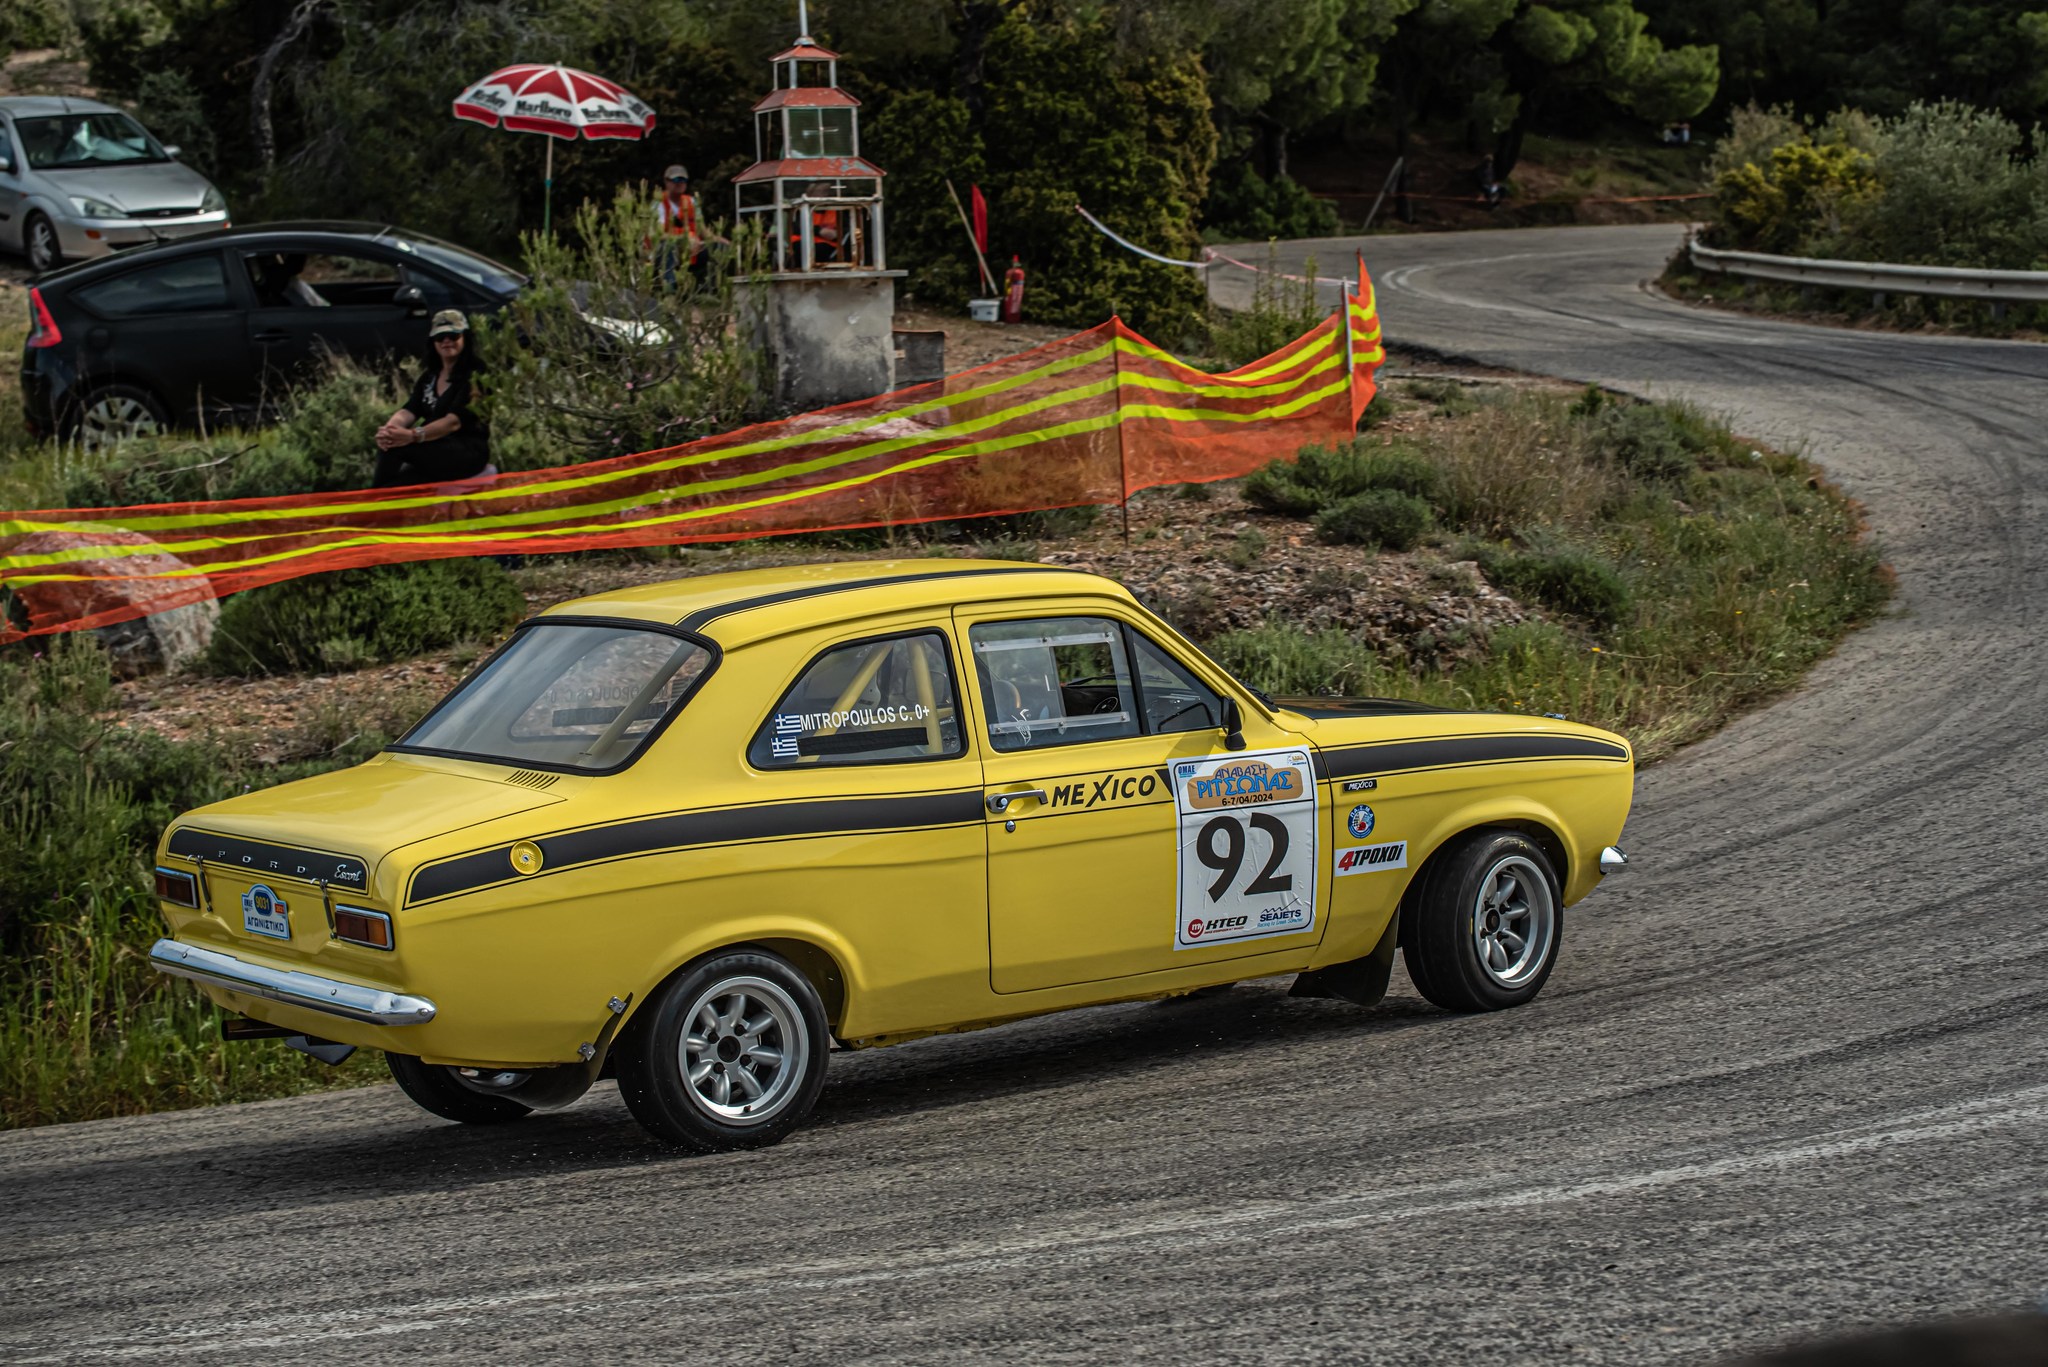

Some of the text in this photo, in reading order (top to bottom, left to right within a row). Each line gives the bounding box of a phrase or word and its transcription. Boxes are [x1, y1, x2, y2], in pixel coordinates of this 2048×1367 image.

[515, 100, 572, 119] Marlboro
[800, 705, 896, 731] MITROPOULOS
[899, 706, 913, 722] C.
[1215, 764, 1268, 779] ΑΝΑΒΑΣΗ
[1051, 774, 1156, 808] MEXICO
[1197, 771, 1293, 798] ΡΙΤΣΩΝΑΣ
[1348, 780, 1374, 791] MEXICO
[1221, 793, 1274, 806] 6-7/04/2024
[218, 851, 363, 883] FORD Escort
[1196, 812, 1292, 903] 92
[247, 916, 285, 933] ΑΓΩΝΙΣΤΙΚΟ
[1259, 909, 1302, 922] SEAJETS
